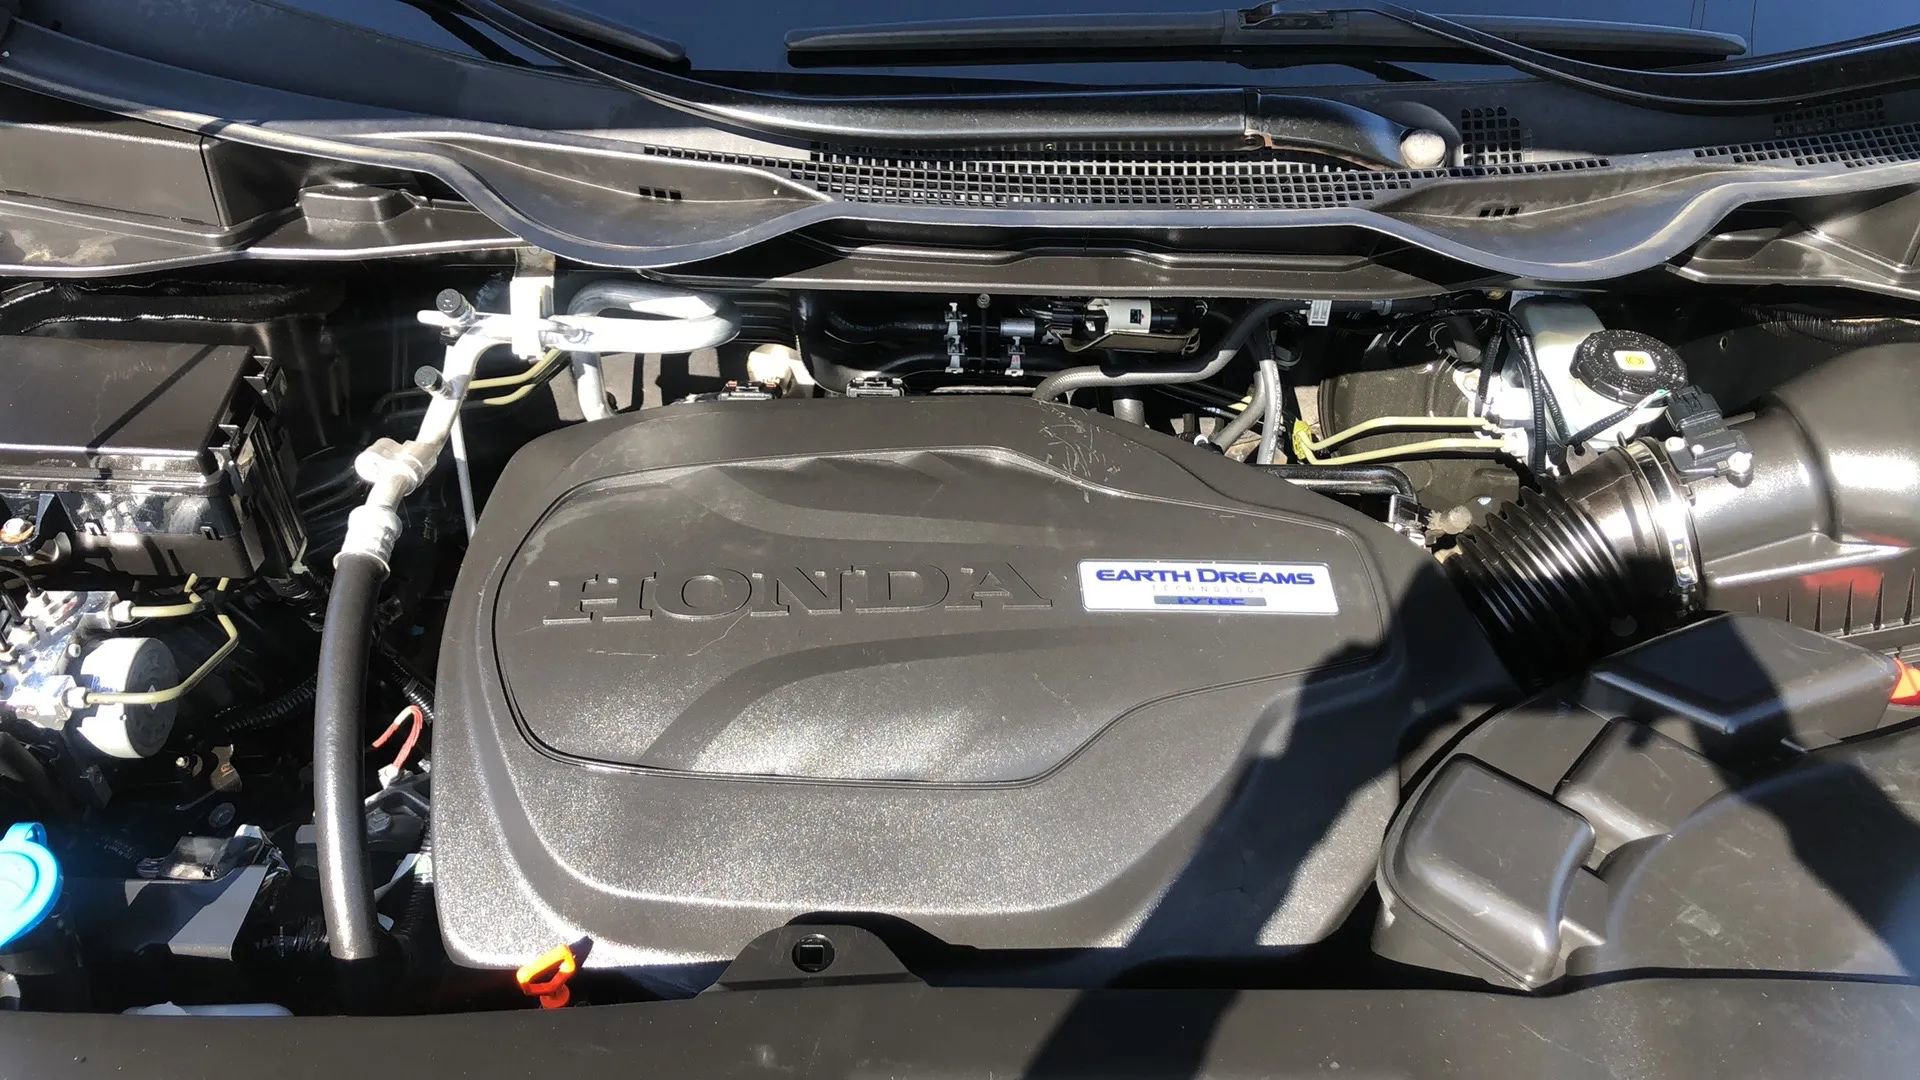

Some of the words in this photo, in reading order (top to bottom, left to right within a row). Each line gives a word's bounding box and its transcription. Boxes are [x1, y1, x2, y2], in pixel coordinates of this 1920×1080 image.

[1096, 569, 1191, 583] EARTH
[1196, 568, 1315, 585] DREAMS
[542, 562, 1053, 624] HONDA
[1152, 584, 1264, 594] TECHNOLOGY
